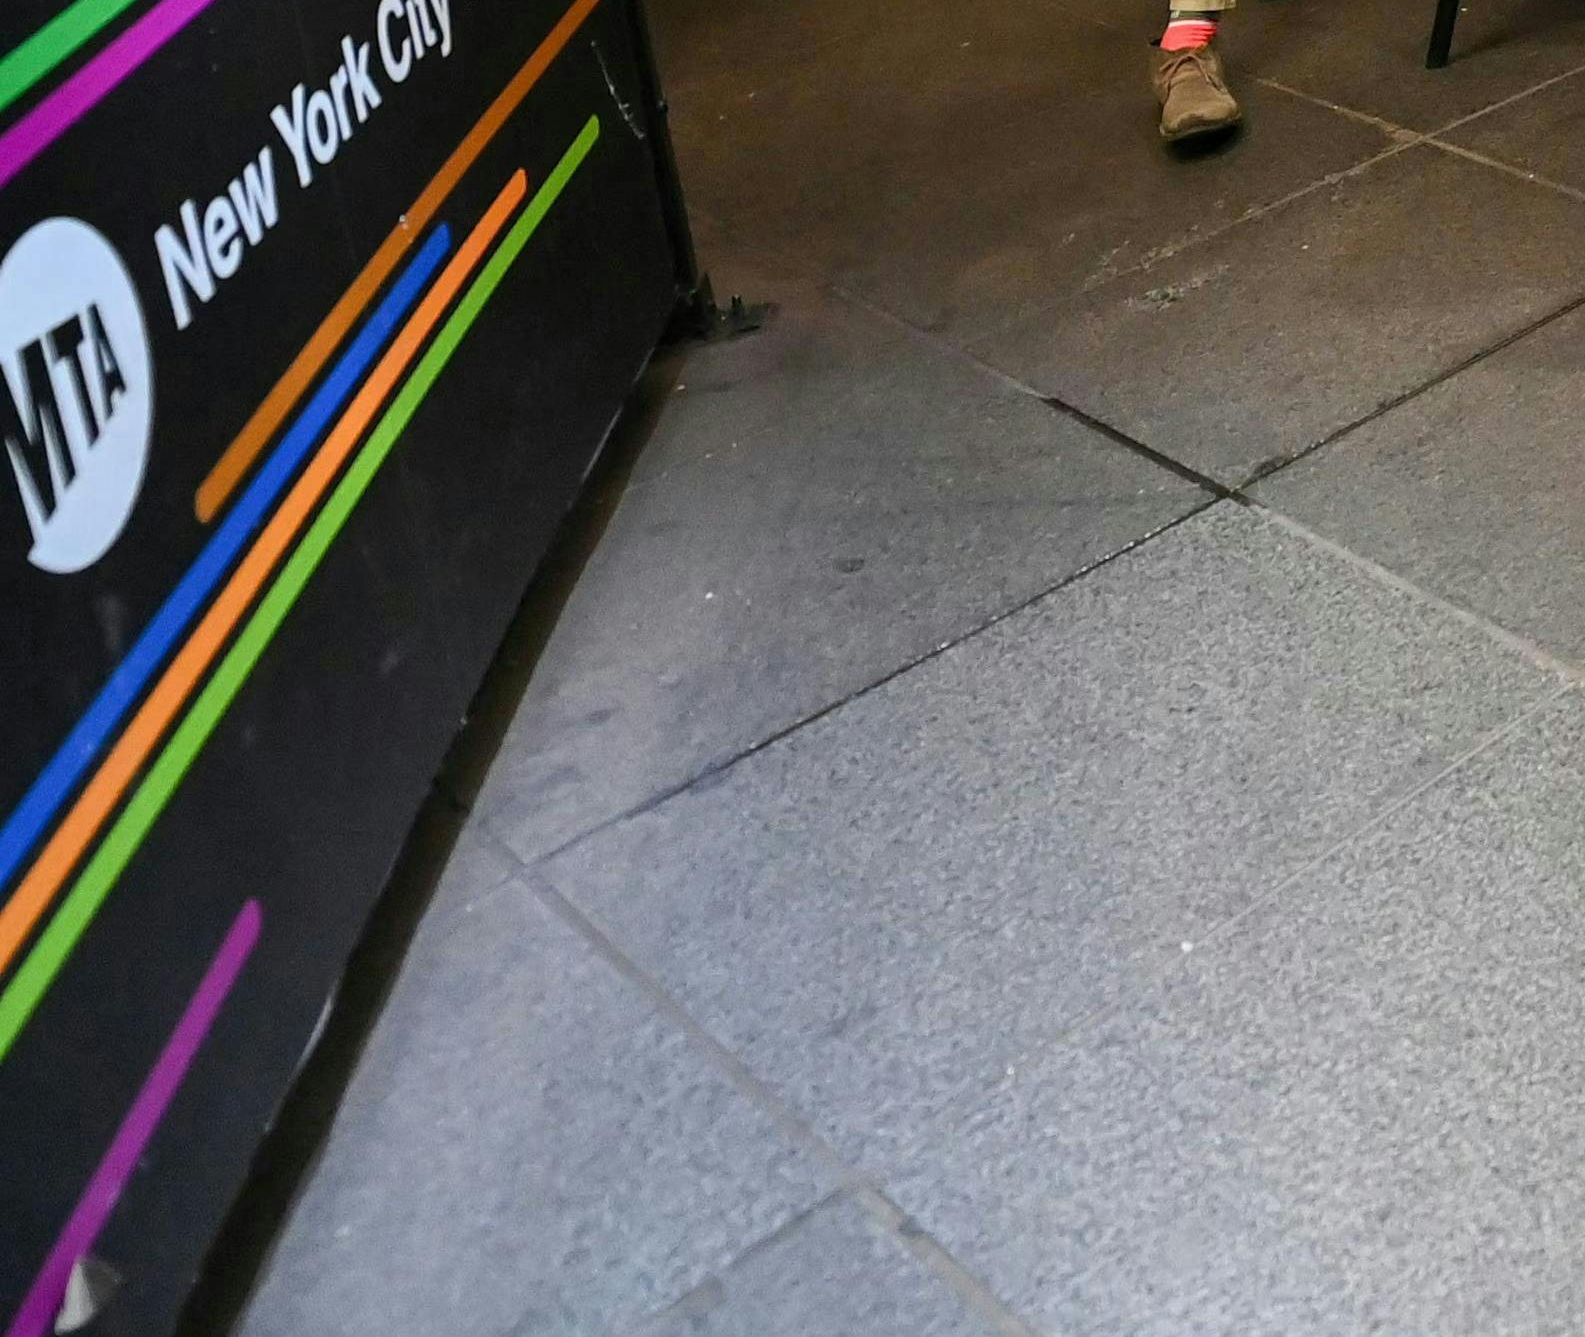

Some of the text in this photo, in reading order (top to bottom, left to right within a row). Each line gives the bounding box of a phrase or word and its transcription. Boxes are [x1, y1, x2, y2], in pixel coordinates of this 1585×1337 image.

[152, 146, 280, 330] New
[270, 35, 382, 188] York
[0, 302, 128, 524] MTA
